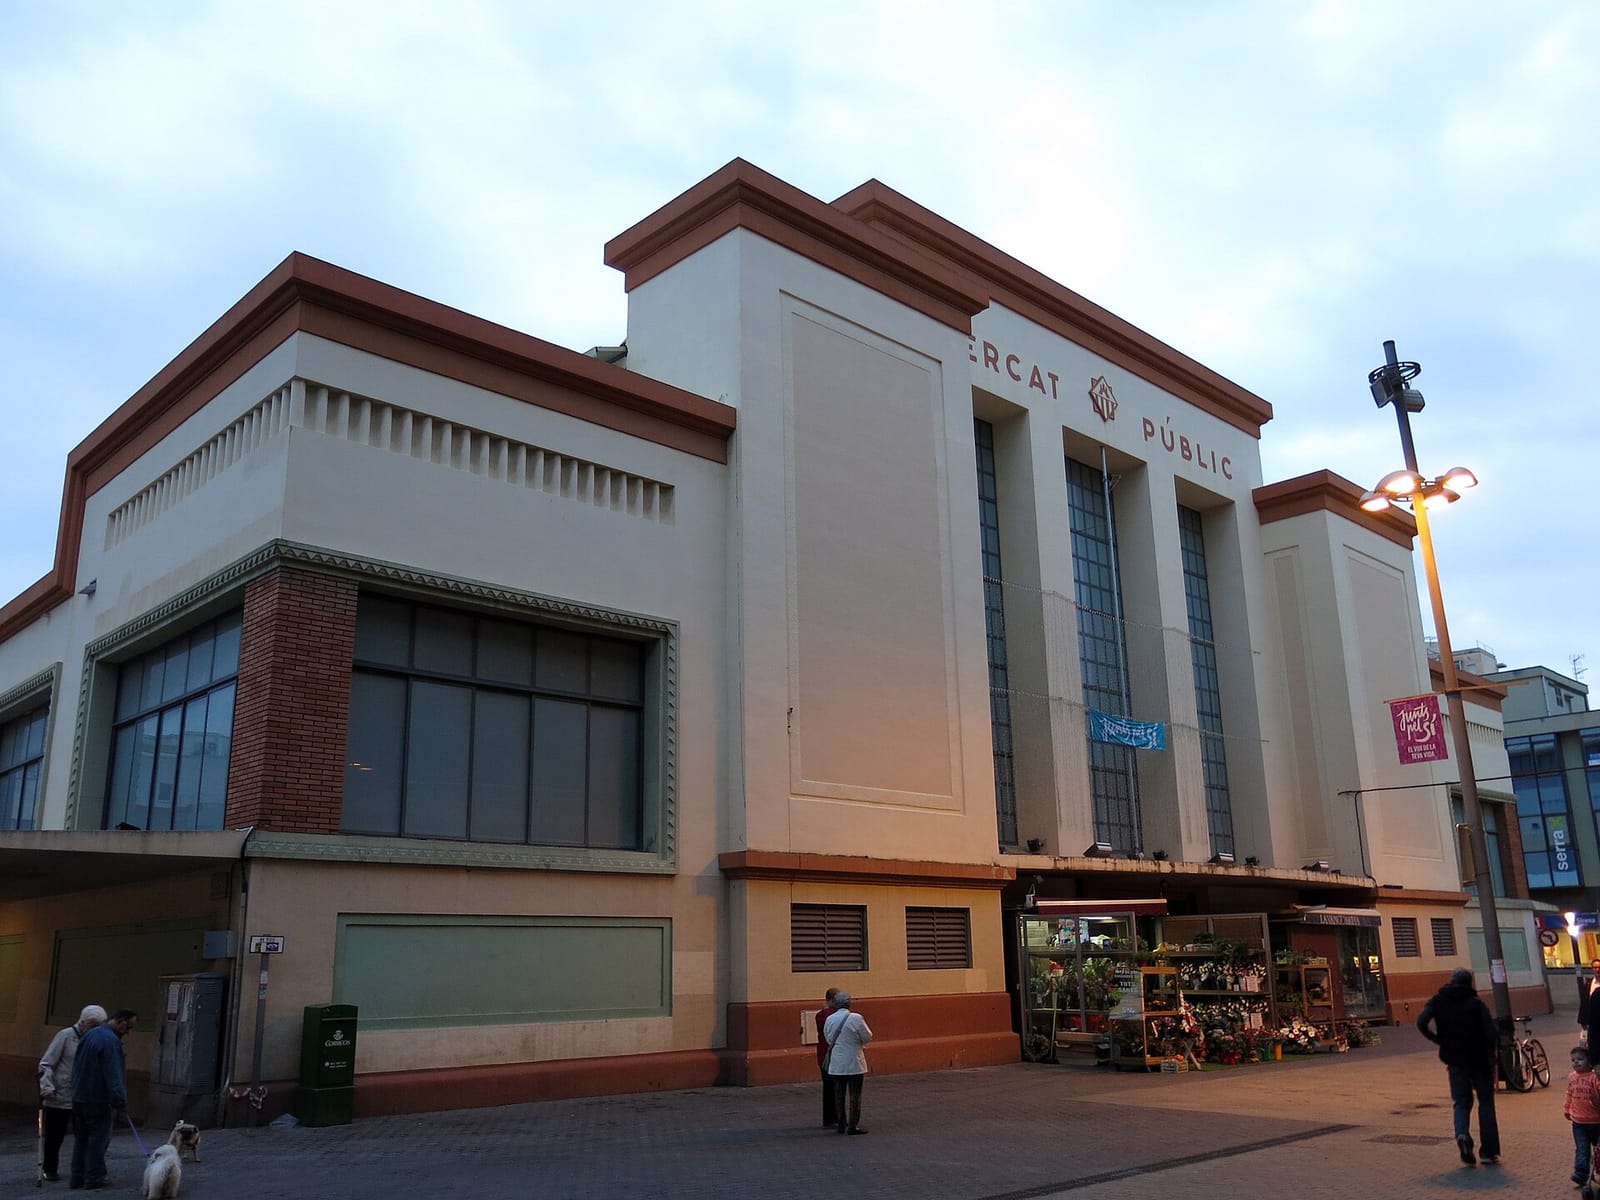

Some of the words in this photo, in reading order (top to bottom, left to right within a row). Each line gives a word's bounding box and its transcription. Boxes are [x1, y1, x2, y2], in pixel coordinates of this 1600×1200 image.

[1142, 416, 1233, 480] PÚBLIC
[1396, 702, 1430, 731] Junts
[1553, 830, 1569, 870] serra
